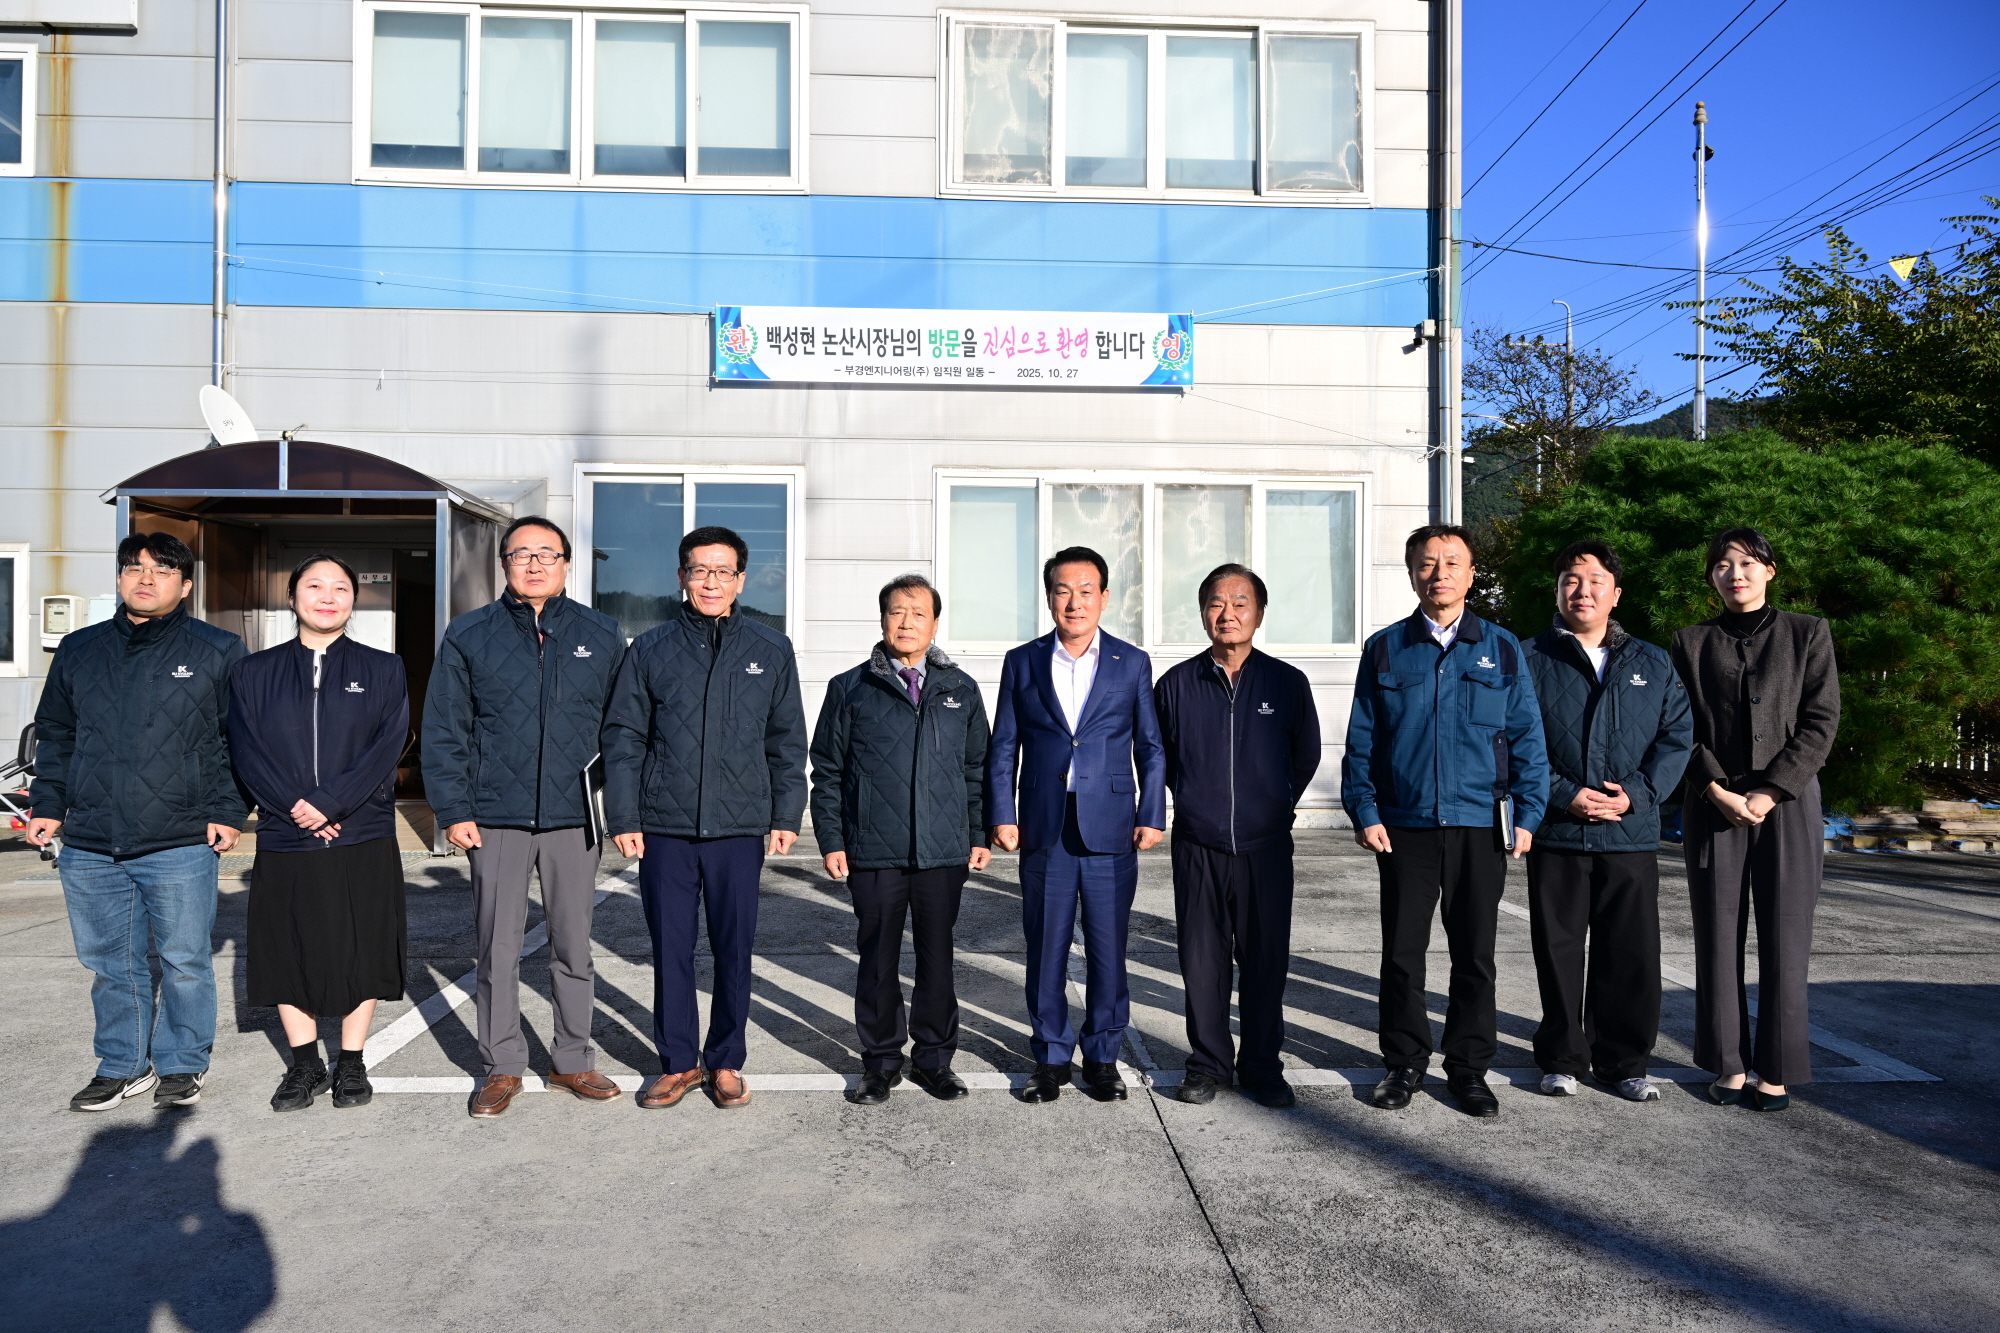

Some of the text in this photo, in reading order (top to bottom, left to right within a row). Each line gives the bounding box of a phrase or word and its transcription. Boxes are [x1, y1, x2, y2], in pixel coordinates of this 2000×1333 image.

[727, 328, 750, 353] 환
[767, 326, 1146, 360] 백성현 논산시장님의 방문을 진심으로 환영 합니다
[1161, 334, 1180, 360] 영
[844, 365, 930, 377] 부경엔지니어링(주)
[933, 366, 962, 377] 임직원
[966, 367, 985, 378] 일동
[1017, 368, 1079, 379] 2025. 10. 27
